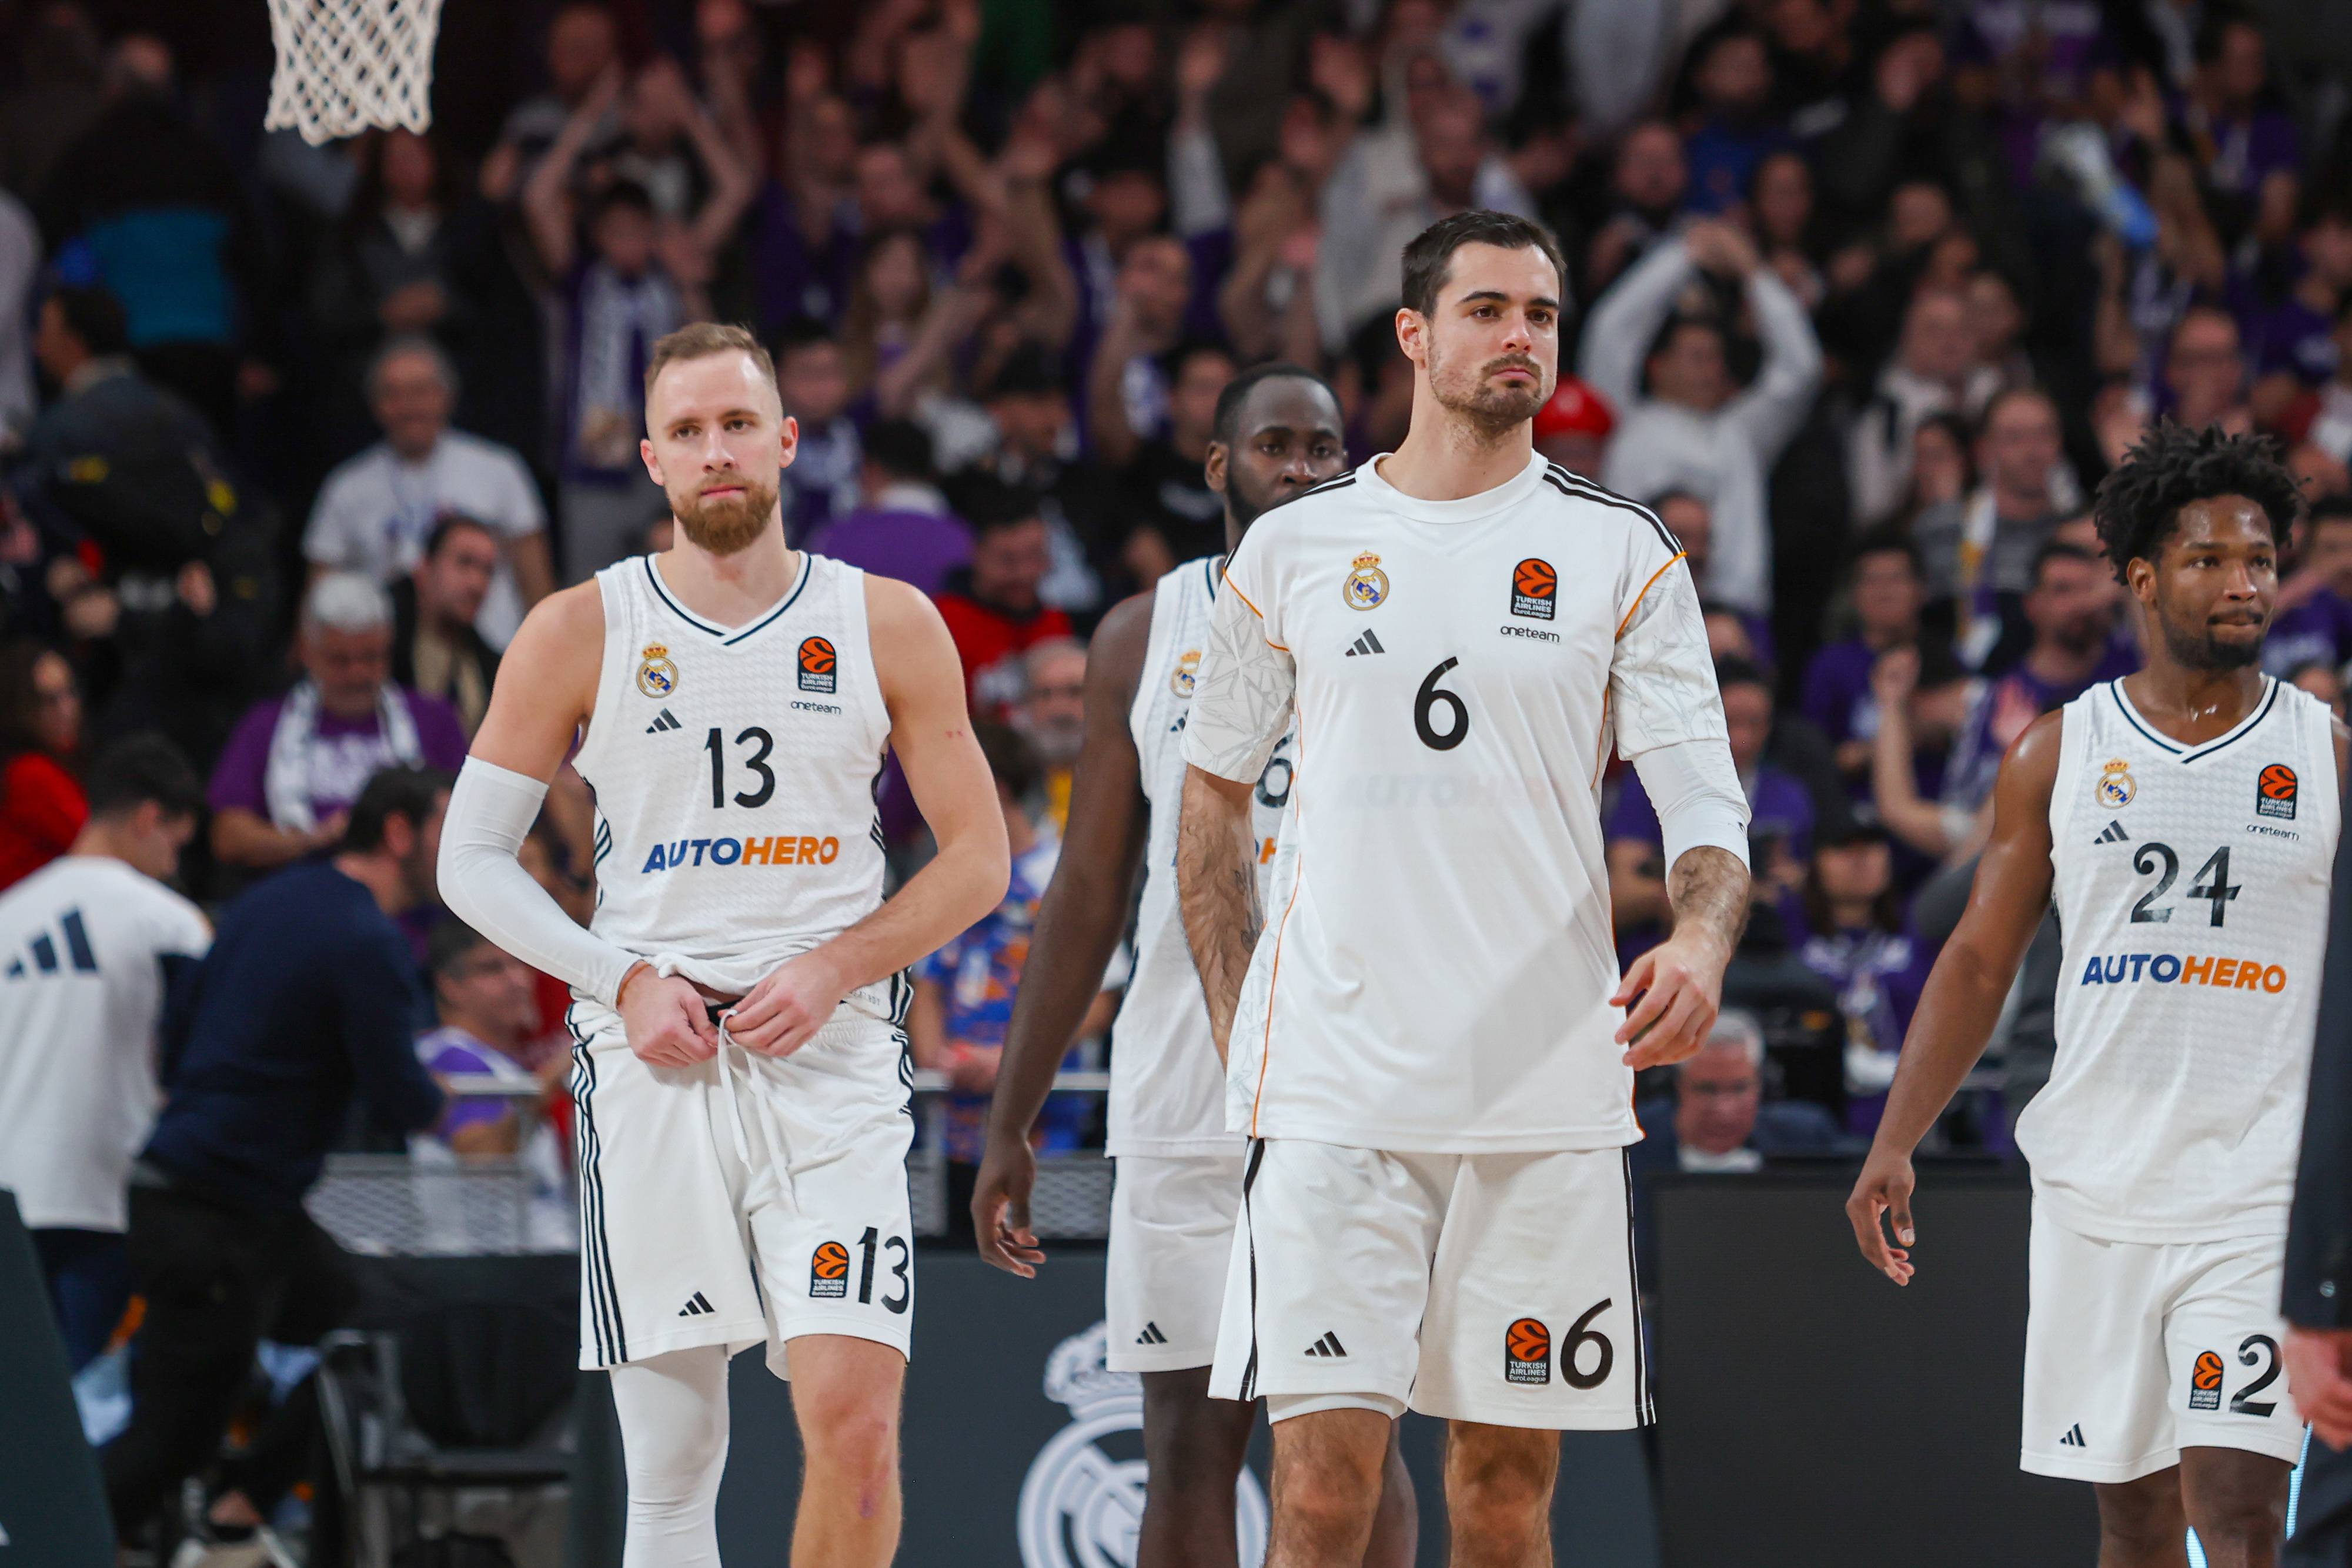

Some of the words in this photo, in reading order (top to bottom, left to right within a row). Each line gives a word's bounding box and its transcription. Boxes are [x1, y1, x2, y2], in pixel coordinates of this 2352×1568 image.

[1514, 602, 1552, 613] AIRLINES
[1515, 596, 1552, 607] TURKISH
[1500, 626, 1560, 643] oneteam
[790, 701, 841, 715] oneteam
[1414, 656, 1469, 751] 6
[704, 727, 776, 808] 13
[2246, 824, 2300, 841] oneteam
[642, 837, 839, 873] AUTOHERO
[2130, 842, 2242, 928] 24
[2081, 954, 2287, 994] AUTOHERO
[856, 1226, 910, 1315] 13
[1560, 1298, 1613, 1390] 6
[1509, 1360, 1547, 1369] TURKISH
[1509, 1368, 1546, 1376] AIRLINES
[1508, 1375, 1546, 1383] EuroLeague
